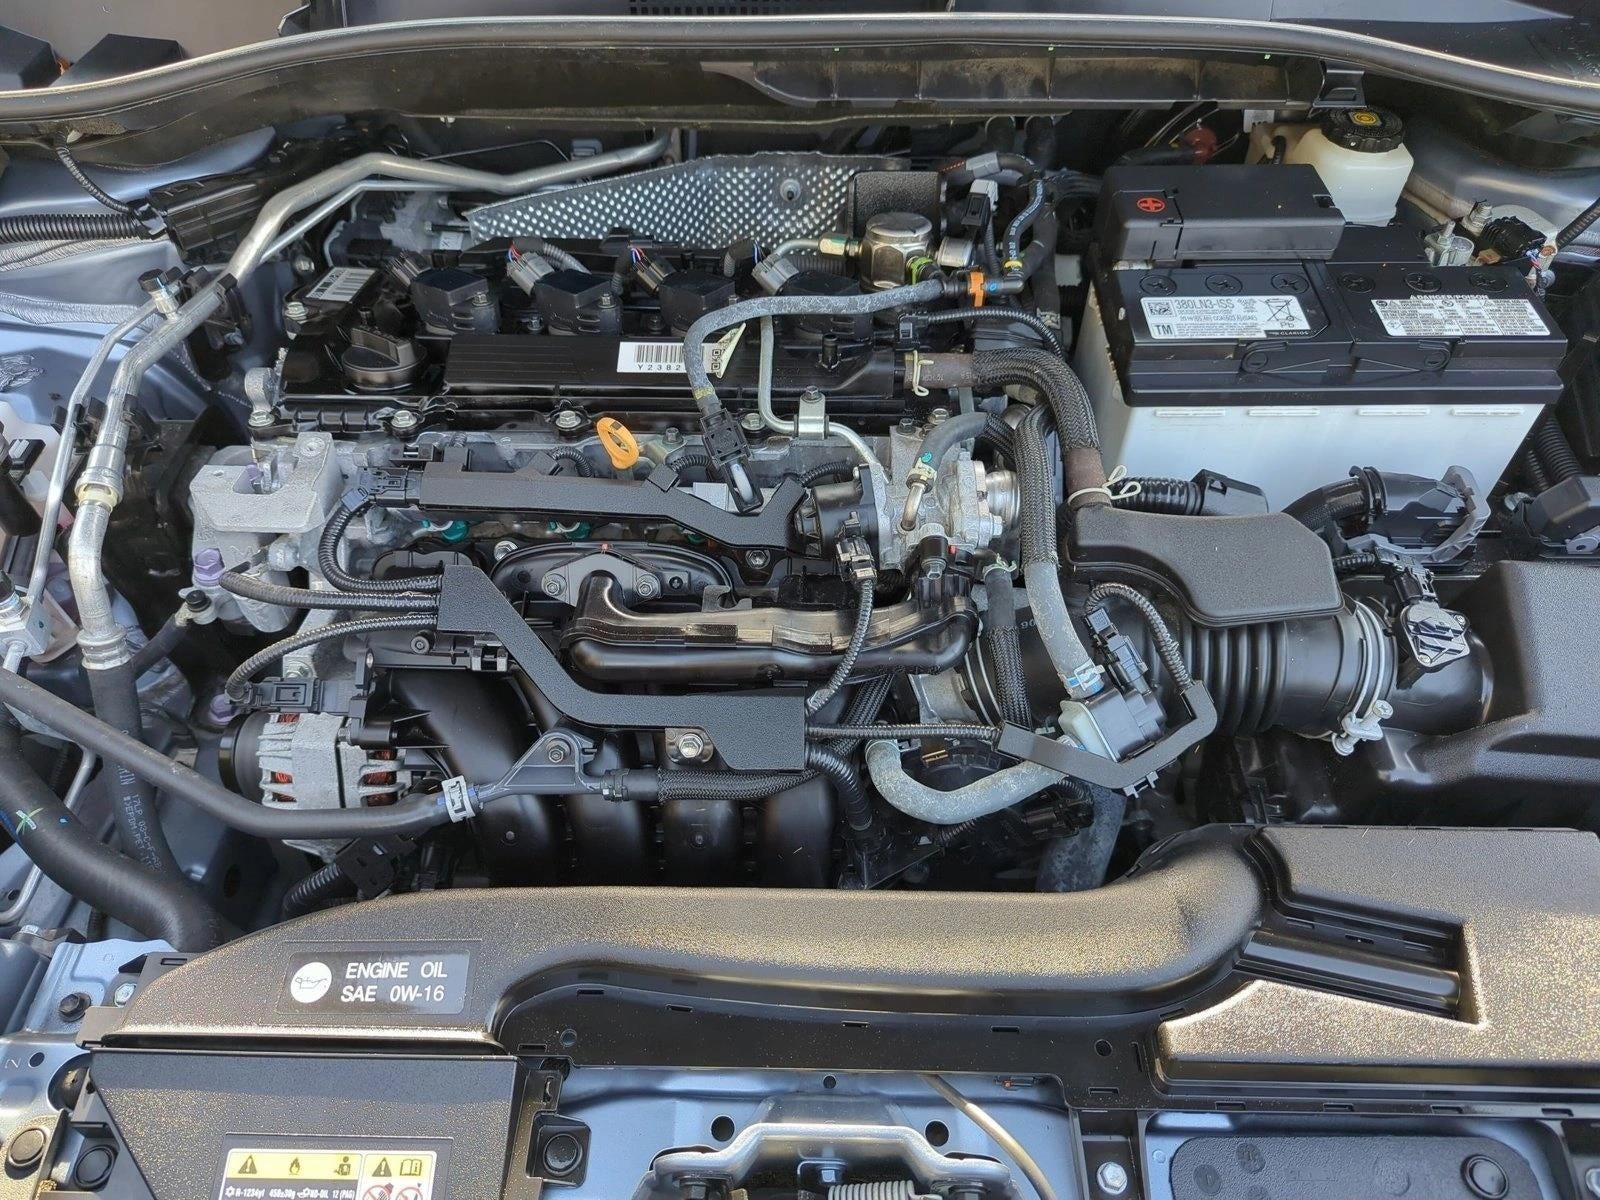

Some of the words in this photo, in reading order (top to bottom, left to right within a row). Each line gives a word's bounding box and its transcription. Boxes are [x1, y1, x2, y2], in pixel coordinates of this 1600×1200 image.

[1175, 299, 1234, 309] 380LN3-ISS
[1155, 325, 1173, 335] TM
[345, 962, 410, 979] ENGINE
[420, 961, 448, 978] OIL
[340, 985, 377, 1002] SAE
[389, 985, 445, 1002] 0W-16
